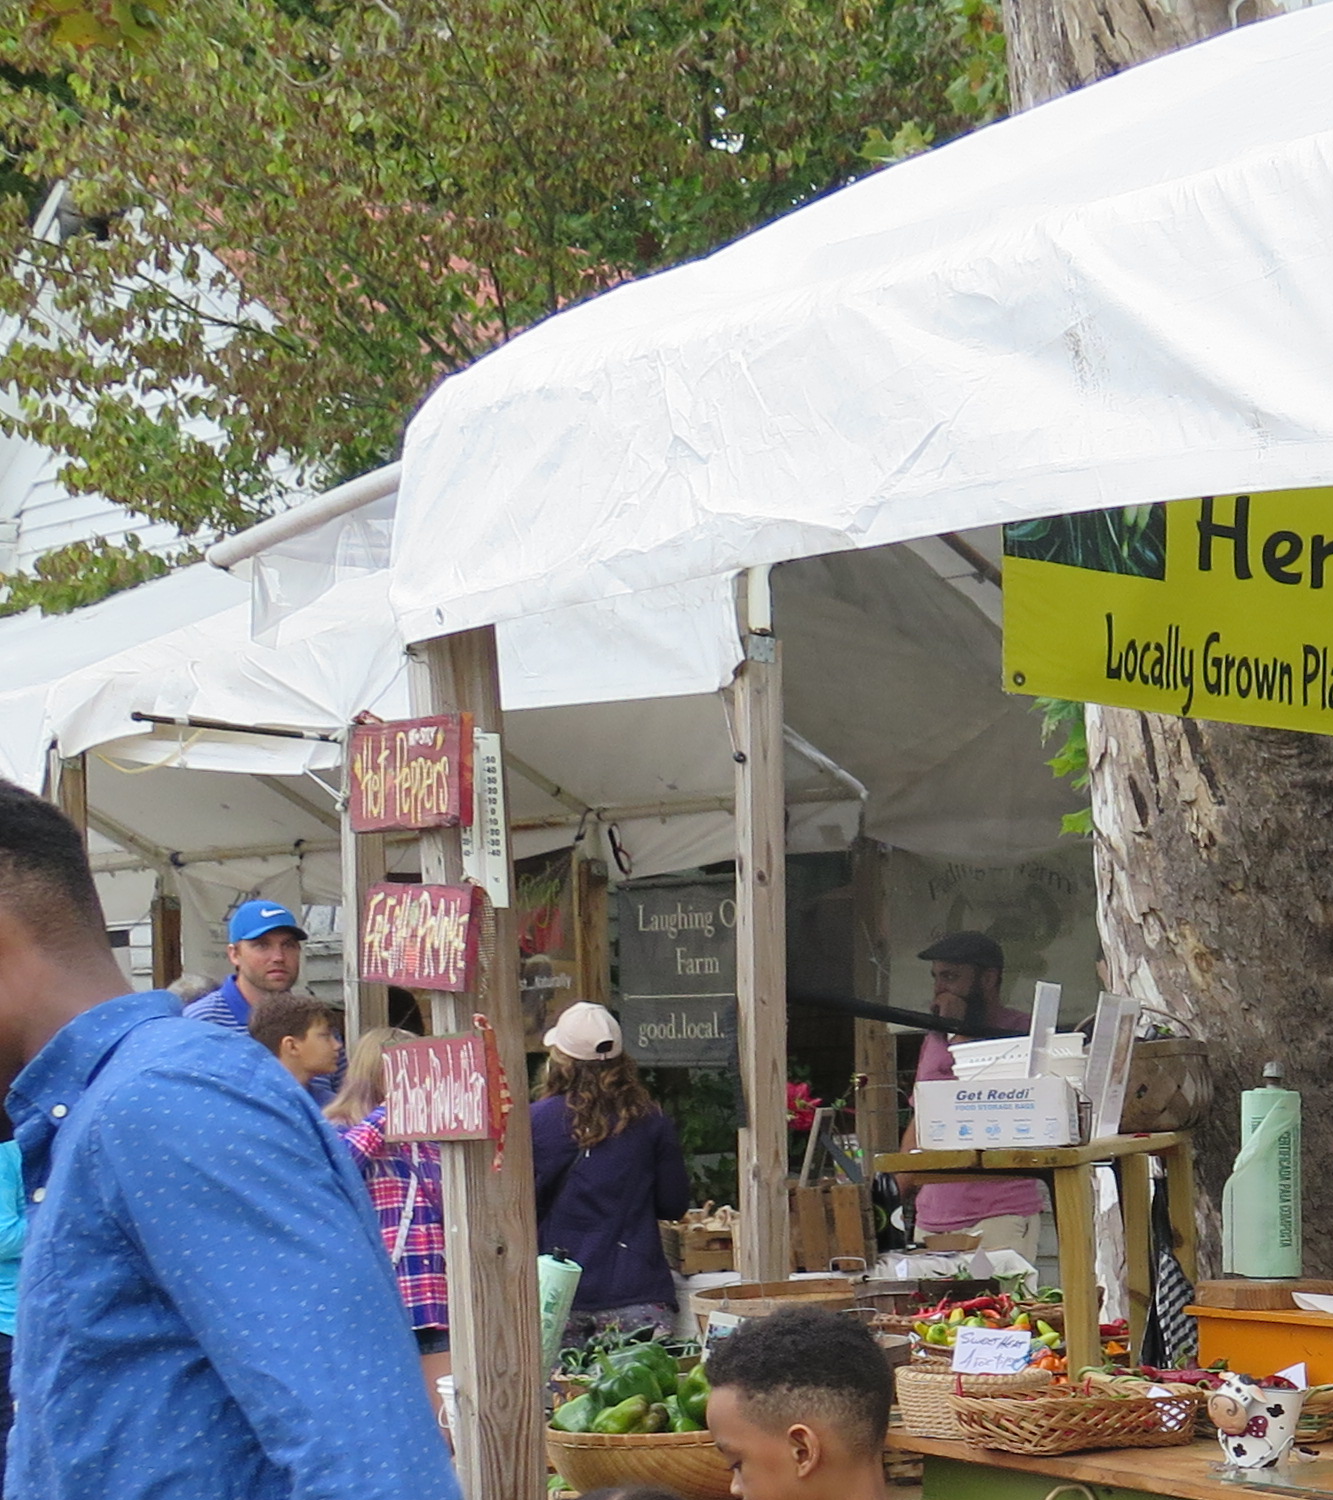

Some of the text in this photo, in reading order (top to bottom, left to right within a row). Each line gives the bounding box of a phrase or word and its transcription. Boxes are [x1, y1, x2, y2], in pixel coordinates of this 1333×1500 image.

[1105, 612, 1194, 716] Locally
[1203, 631, 1293, 706] Grown
[362, 731, 449, 825] Hot Peppers
[638, 903, 714, 939] Laughing
[675, 947, 720, 976] Farm
[638, 1012, 726, 1048] good.local.
[955, 1088, 1030, 1101] Get Reddi
